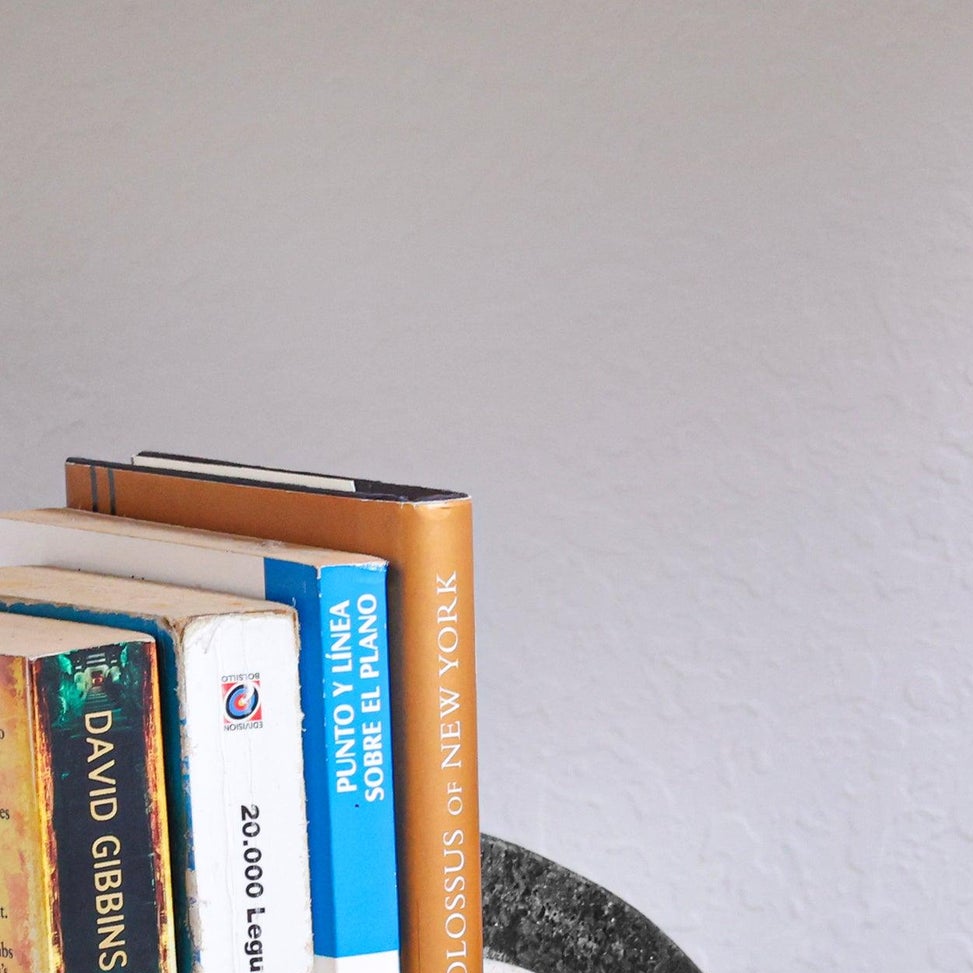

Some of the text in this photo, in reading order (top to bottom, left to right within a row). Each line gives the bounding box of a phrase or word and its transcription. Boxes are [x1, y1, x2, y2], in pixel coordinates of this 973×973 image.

[435, 570, 459, 671] YORK
[324, 599, 357, 794] PUNTO Y LÍNEA
[357, 593, 385, 801] SOBRE EL PLANO
[440, 686, 462, 769] NEW
[84, 710, 128, 971] DAVID GIBBINS
[447, 781, 463, 816] OF
[241, 804, 265, 898] 20.000
